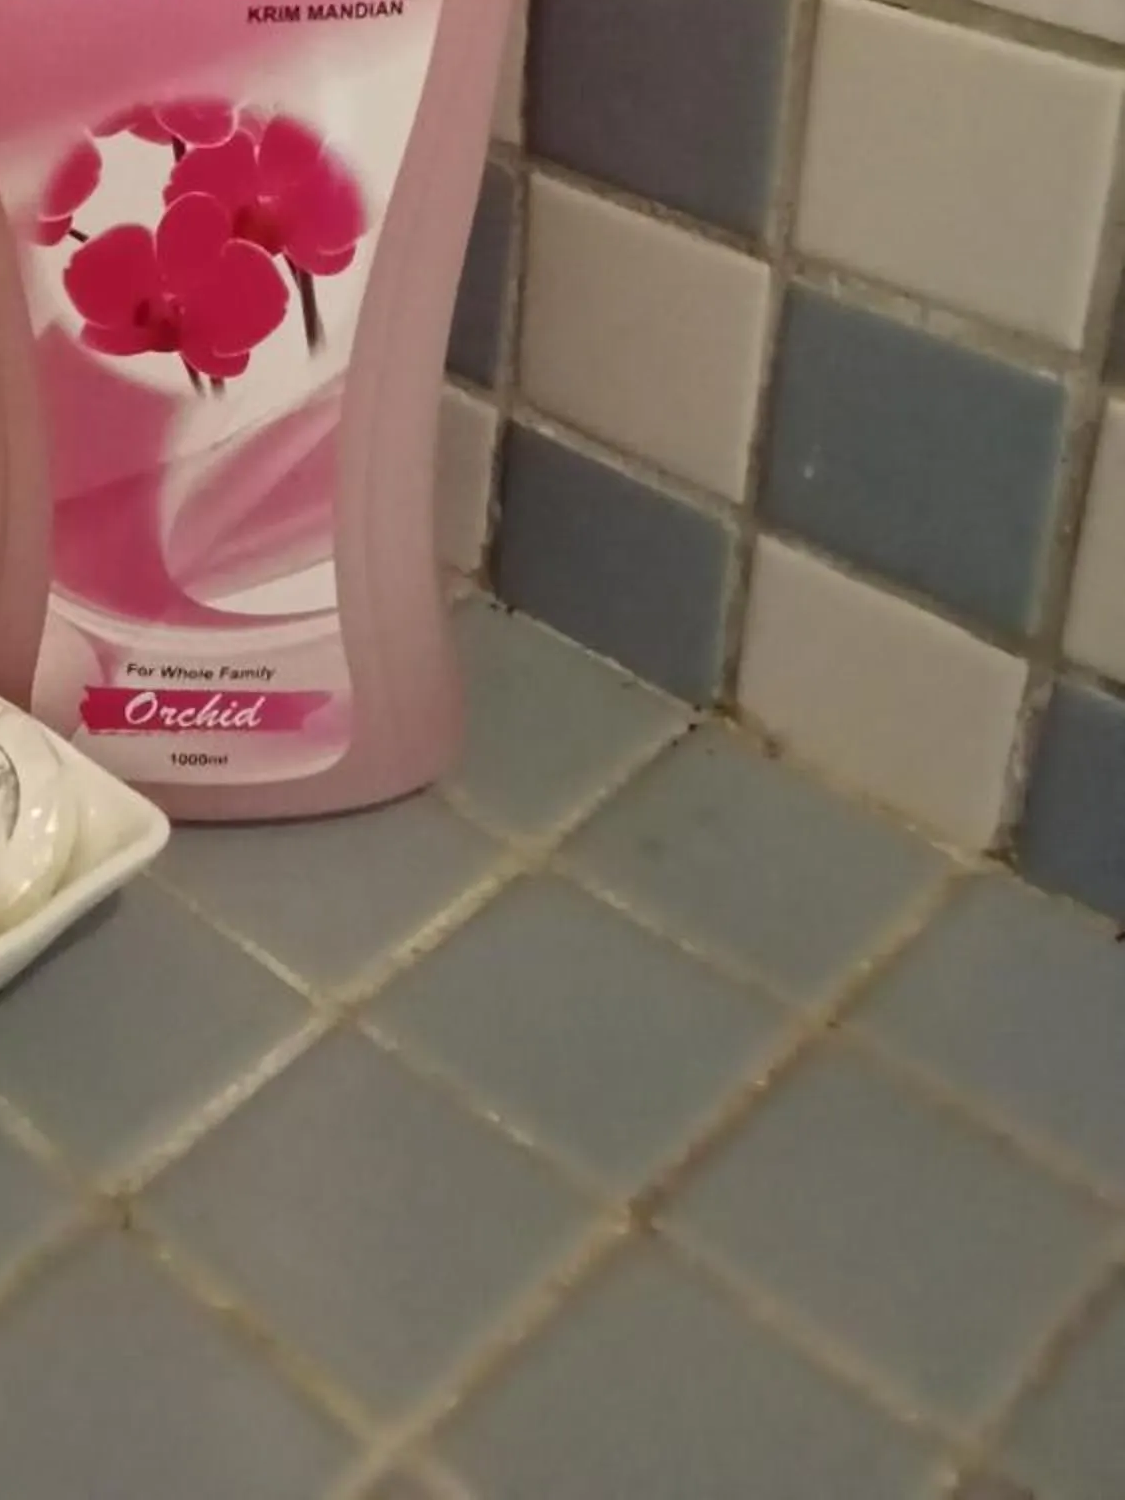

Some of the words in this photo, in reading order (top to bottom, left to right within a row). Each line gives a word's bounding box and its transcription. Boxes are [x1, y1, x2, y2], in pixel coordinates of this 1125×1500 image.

[247, 4, 302, 24] KRIM
[307, 0, 404, 22] MANDIAN
[126, 663, 154, 678] For
[160, 665, 214, 680] Whole
[219, 665, 275, 681] Family
[124, 691, 266, 728] Orchid
[171, 753, 228, 767] 1000ml
